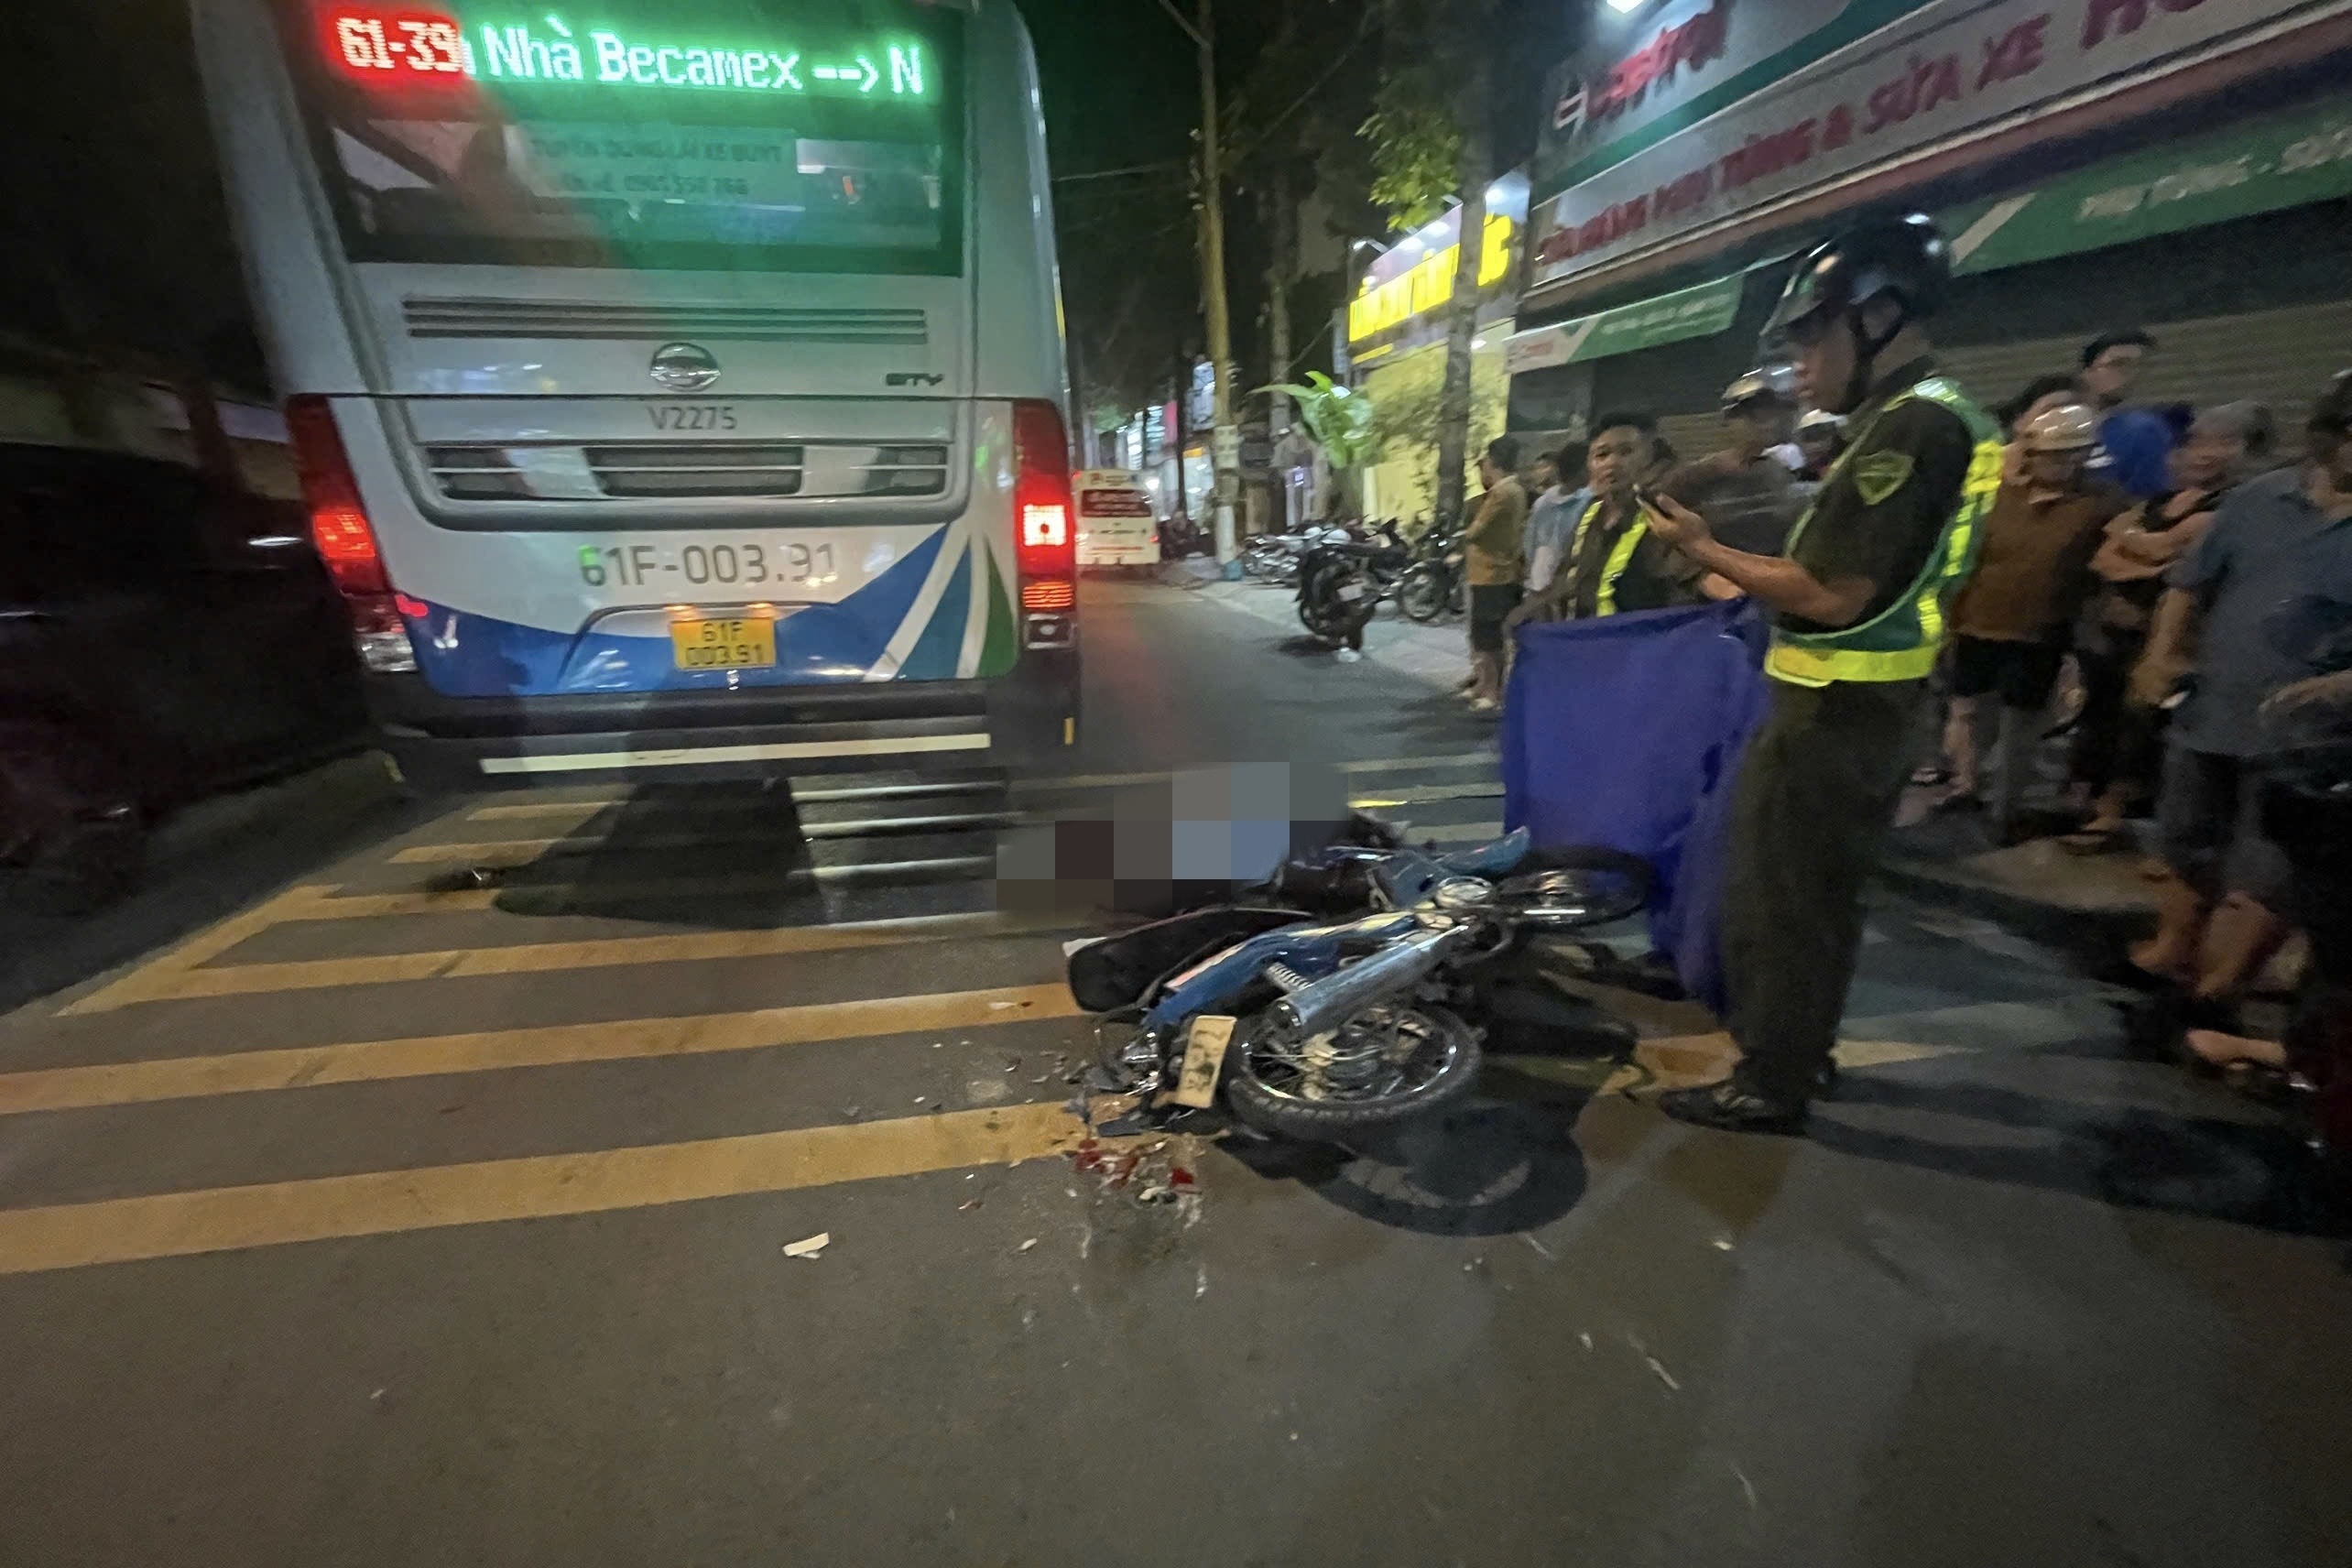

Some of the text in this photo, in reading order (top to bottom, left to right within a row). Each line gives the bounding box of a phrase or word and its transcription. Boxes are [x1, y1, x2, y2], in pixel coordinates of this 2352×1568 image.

[336, 17, 463, 72] 61-39
[481, 14, 584, 81] Nhà
[589, 30, 803, 91] Becamex
[887, 44, 922, 94] N
[647, 406, 738, 430] V2275
[579, 543, 837, 587] 61F-003.91
[702, 621, 744, 642] 61F
